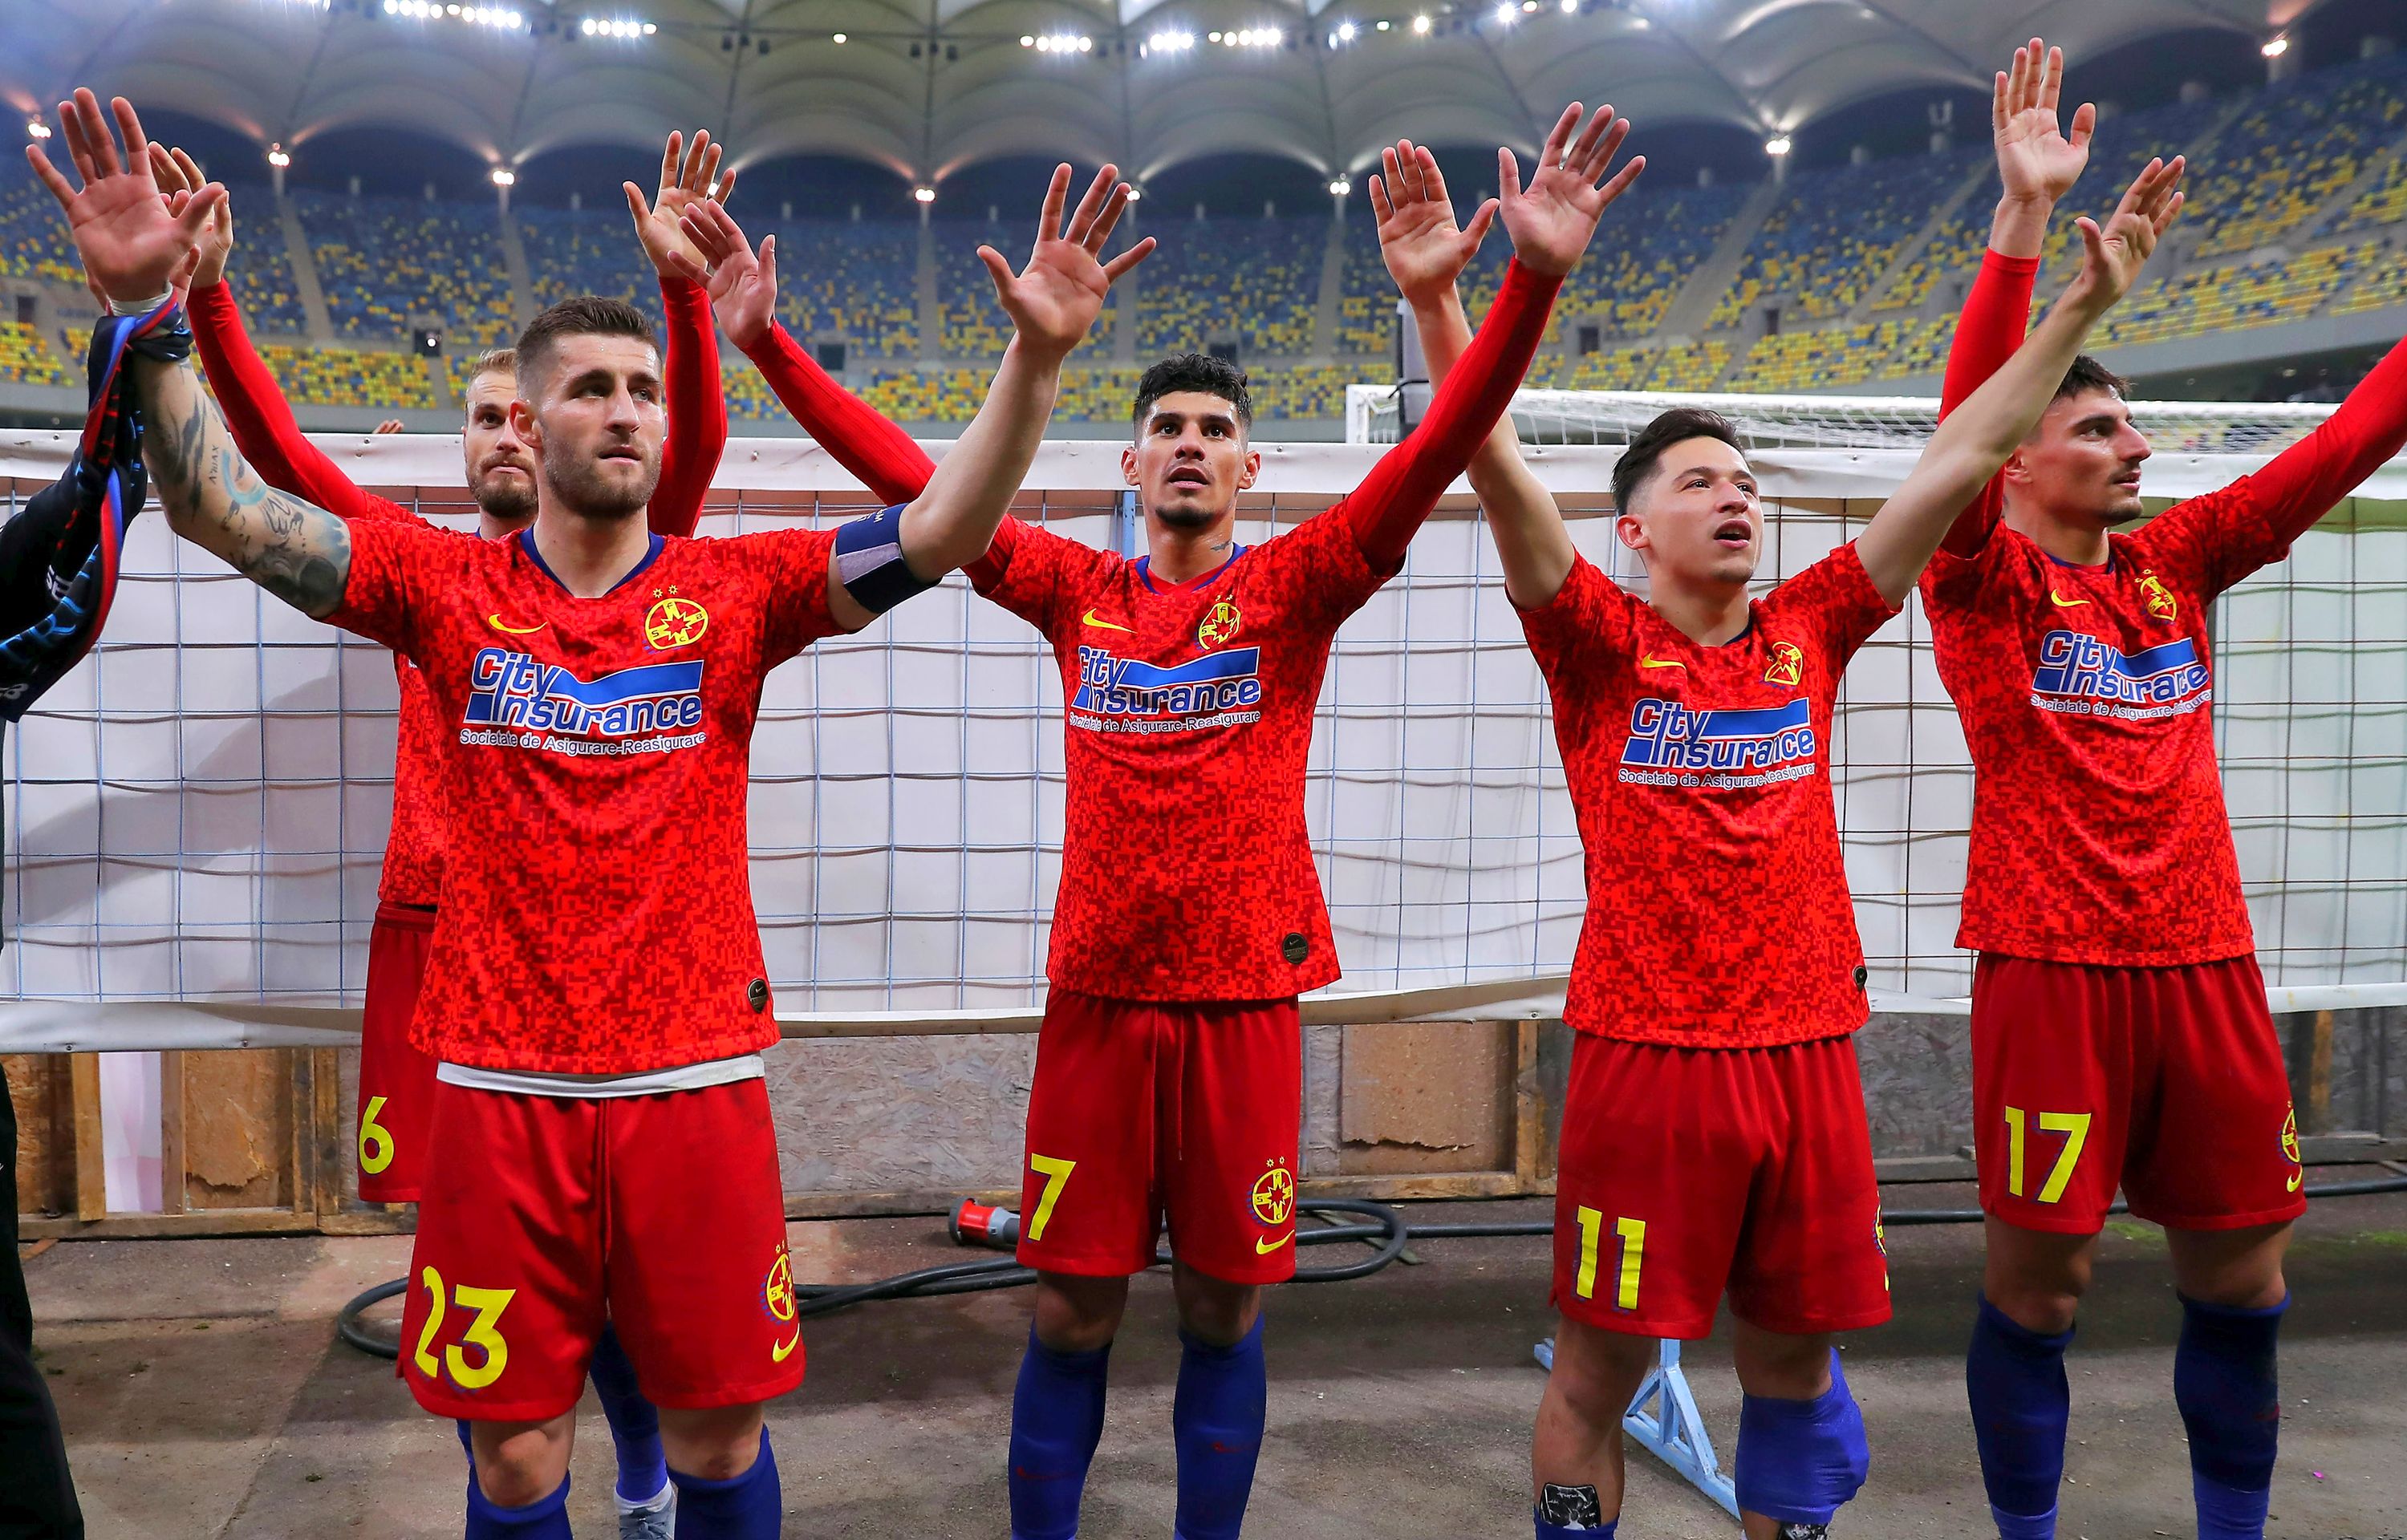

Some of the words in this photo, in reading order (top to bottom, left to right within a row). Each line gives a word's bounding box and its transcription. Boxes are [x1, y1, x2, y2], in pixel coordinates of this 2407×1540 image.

[472, 647, 561, 702] City
[1078, 646, 1129, 693] City
[2040, 630, 2117, 676] City
[489, 691, 703, 736] Insurance
[1087, 678, 1260, 715] Insurance
[2092, 703, 2110, 715] de
[460, 728, 518, 746] Societate
[520, 732, 540, 749] de
[544, 731, 707, 756] Asigurare-Reasigurare
[1103, 717, 1120, 732] de
[1631, 698, 1710, 744] City
[1618, 768, 1677, 785] Societate
[1680, 773, 1699, 787] de
[359, 1096, 395, 1174] 6
[2004, 1105, 2092, 1203] 17
[1028, 1153, 1077, 1241] 7
[1577, 1205, 1646, 1310] 11
[414, 1266, 516, 1388] 23
